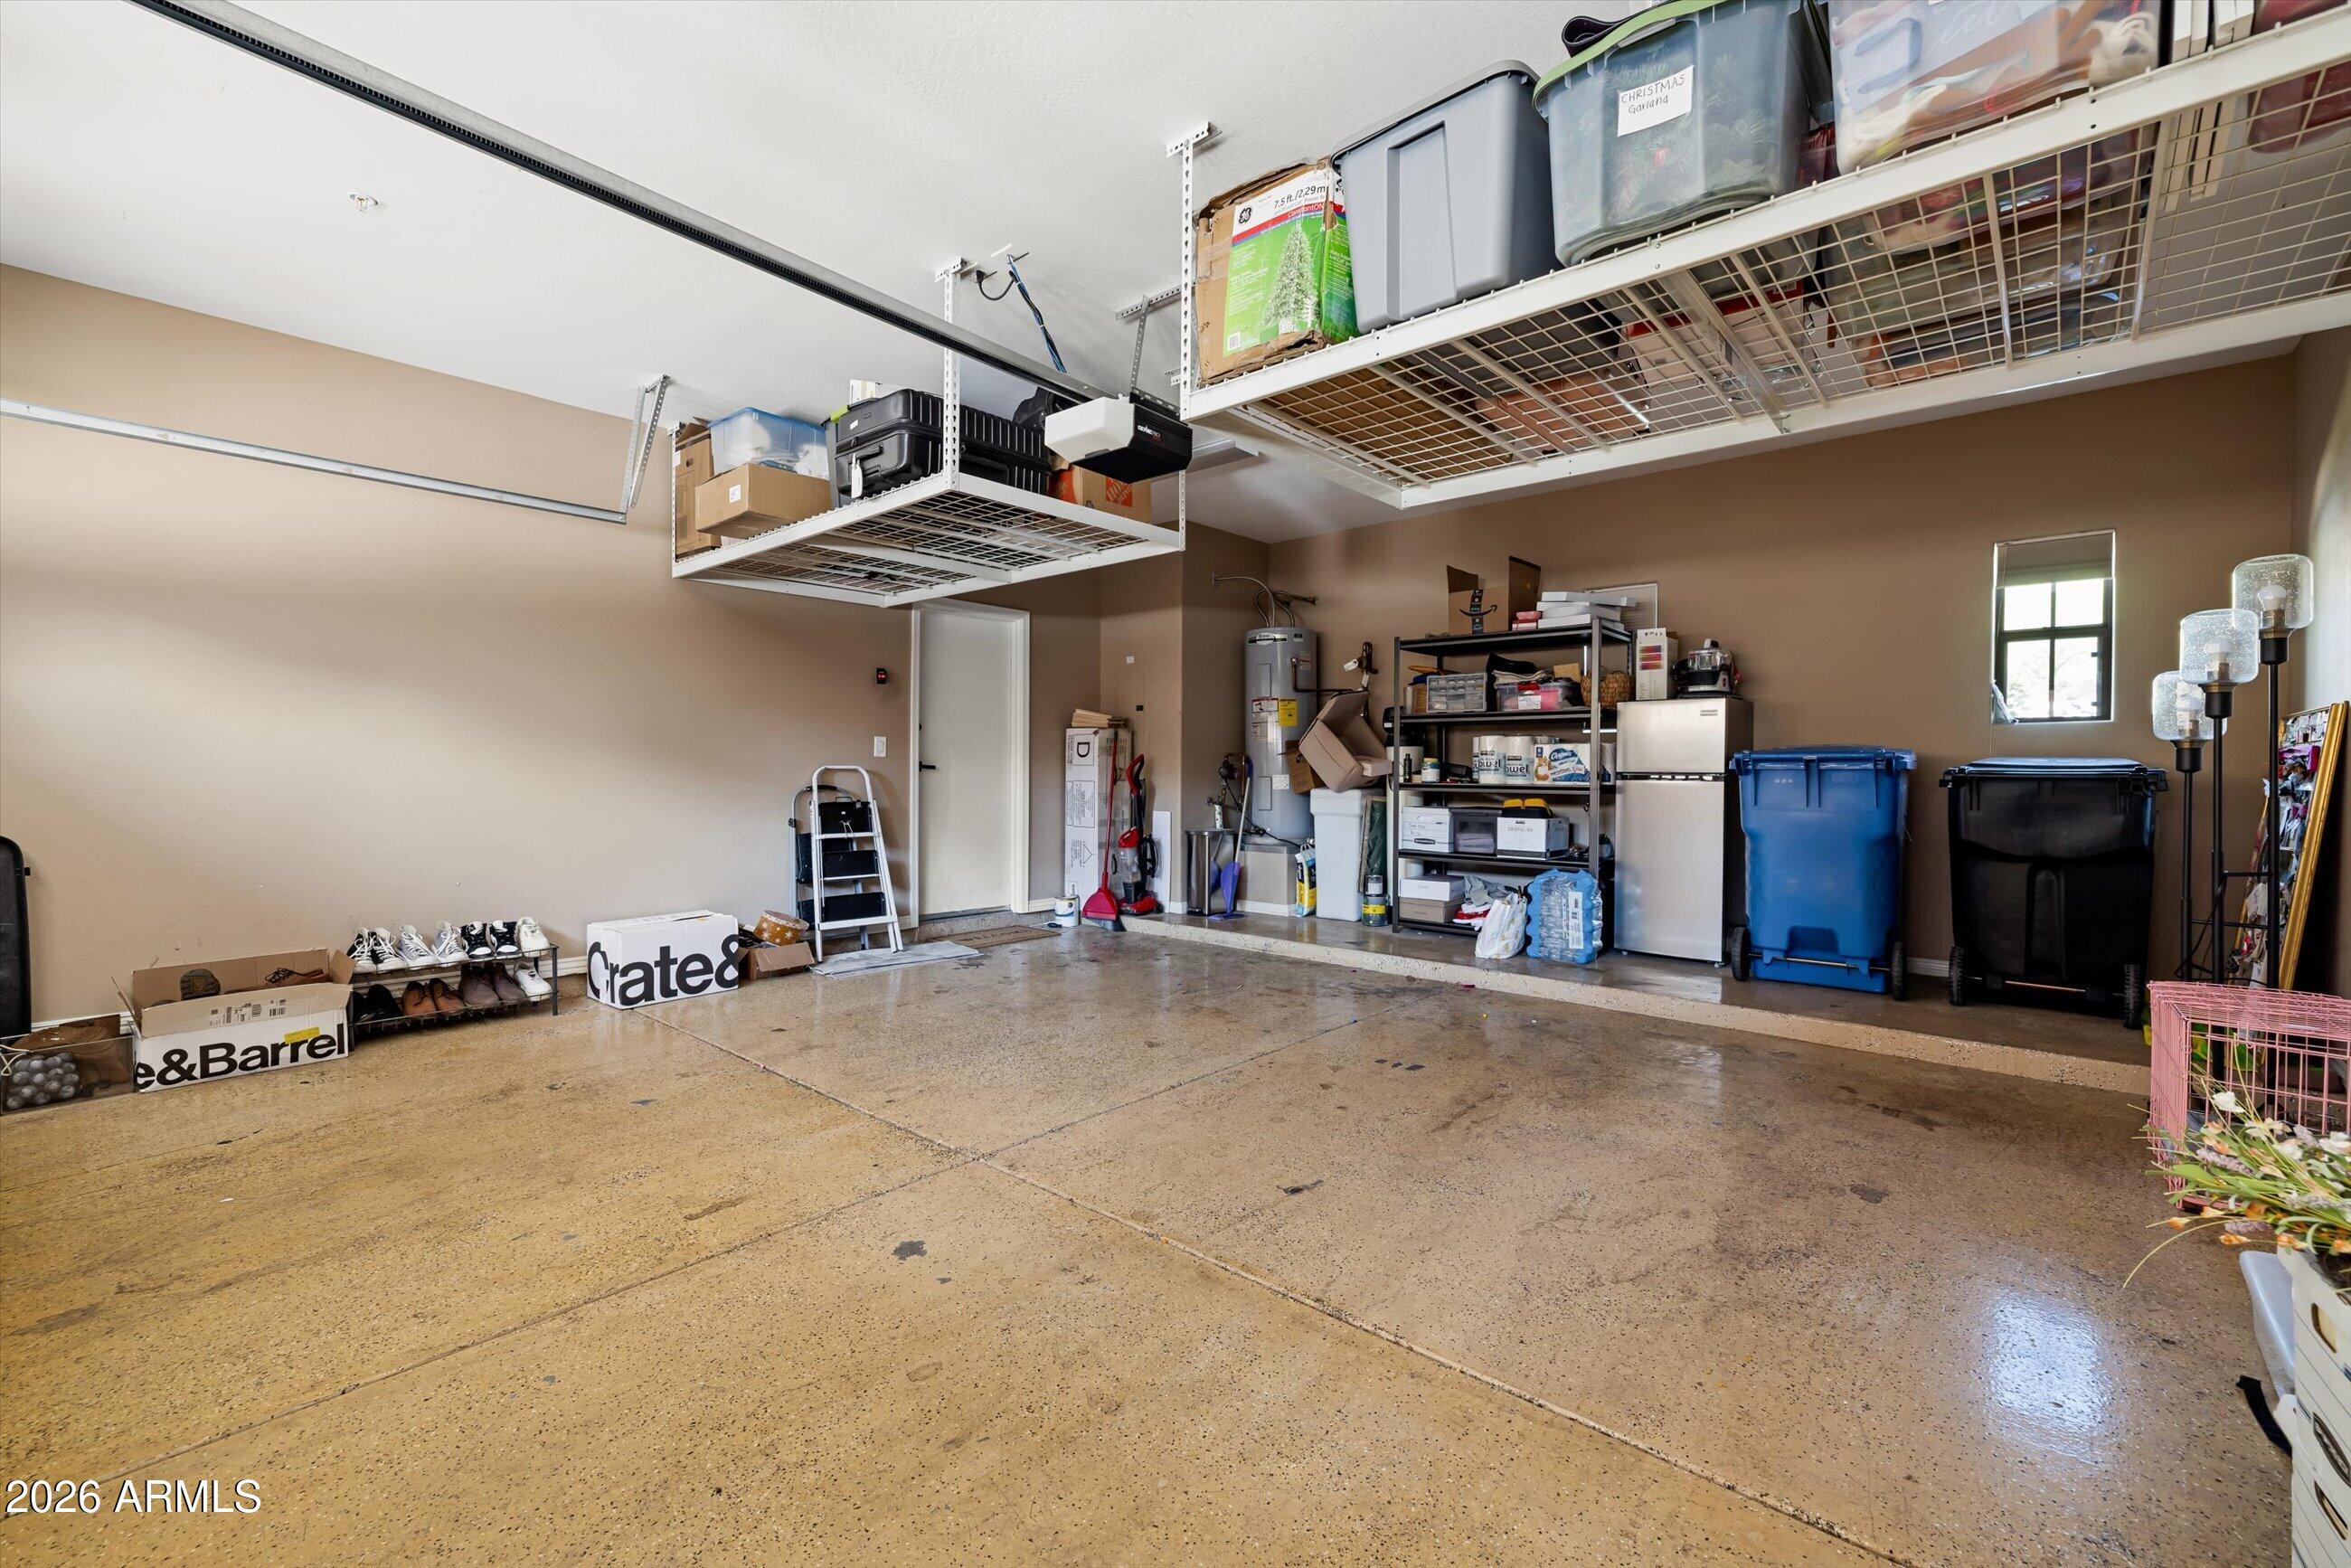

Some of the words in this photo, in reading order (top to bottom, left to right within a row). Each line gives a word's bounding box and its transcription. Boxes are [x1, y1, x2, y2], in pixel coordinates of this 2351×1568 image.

[1621, 73, 1685, 104] CHRISTMAS
[1629, 95, 1668, 115] Garland
[1076, 741, 1091, 758] D
[588, 934, 739, 1006] Crate&
